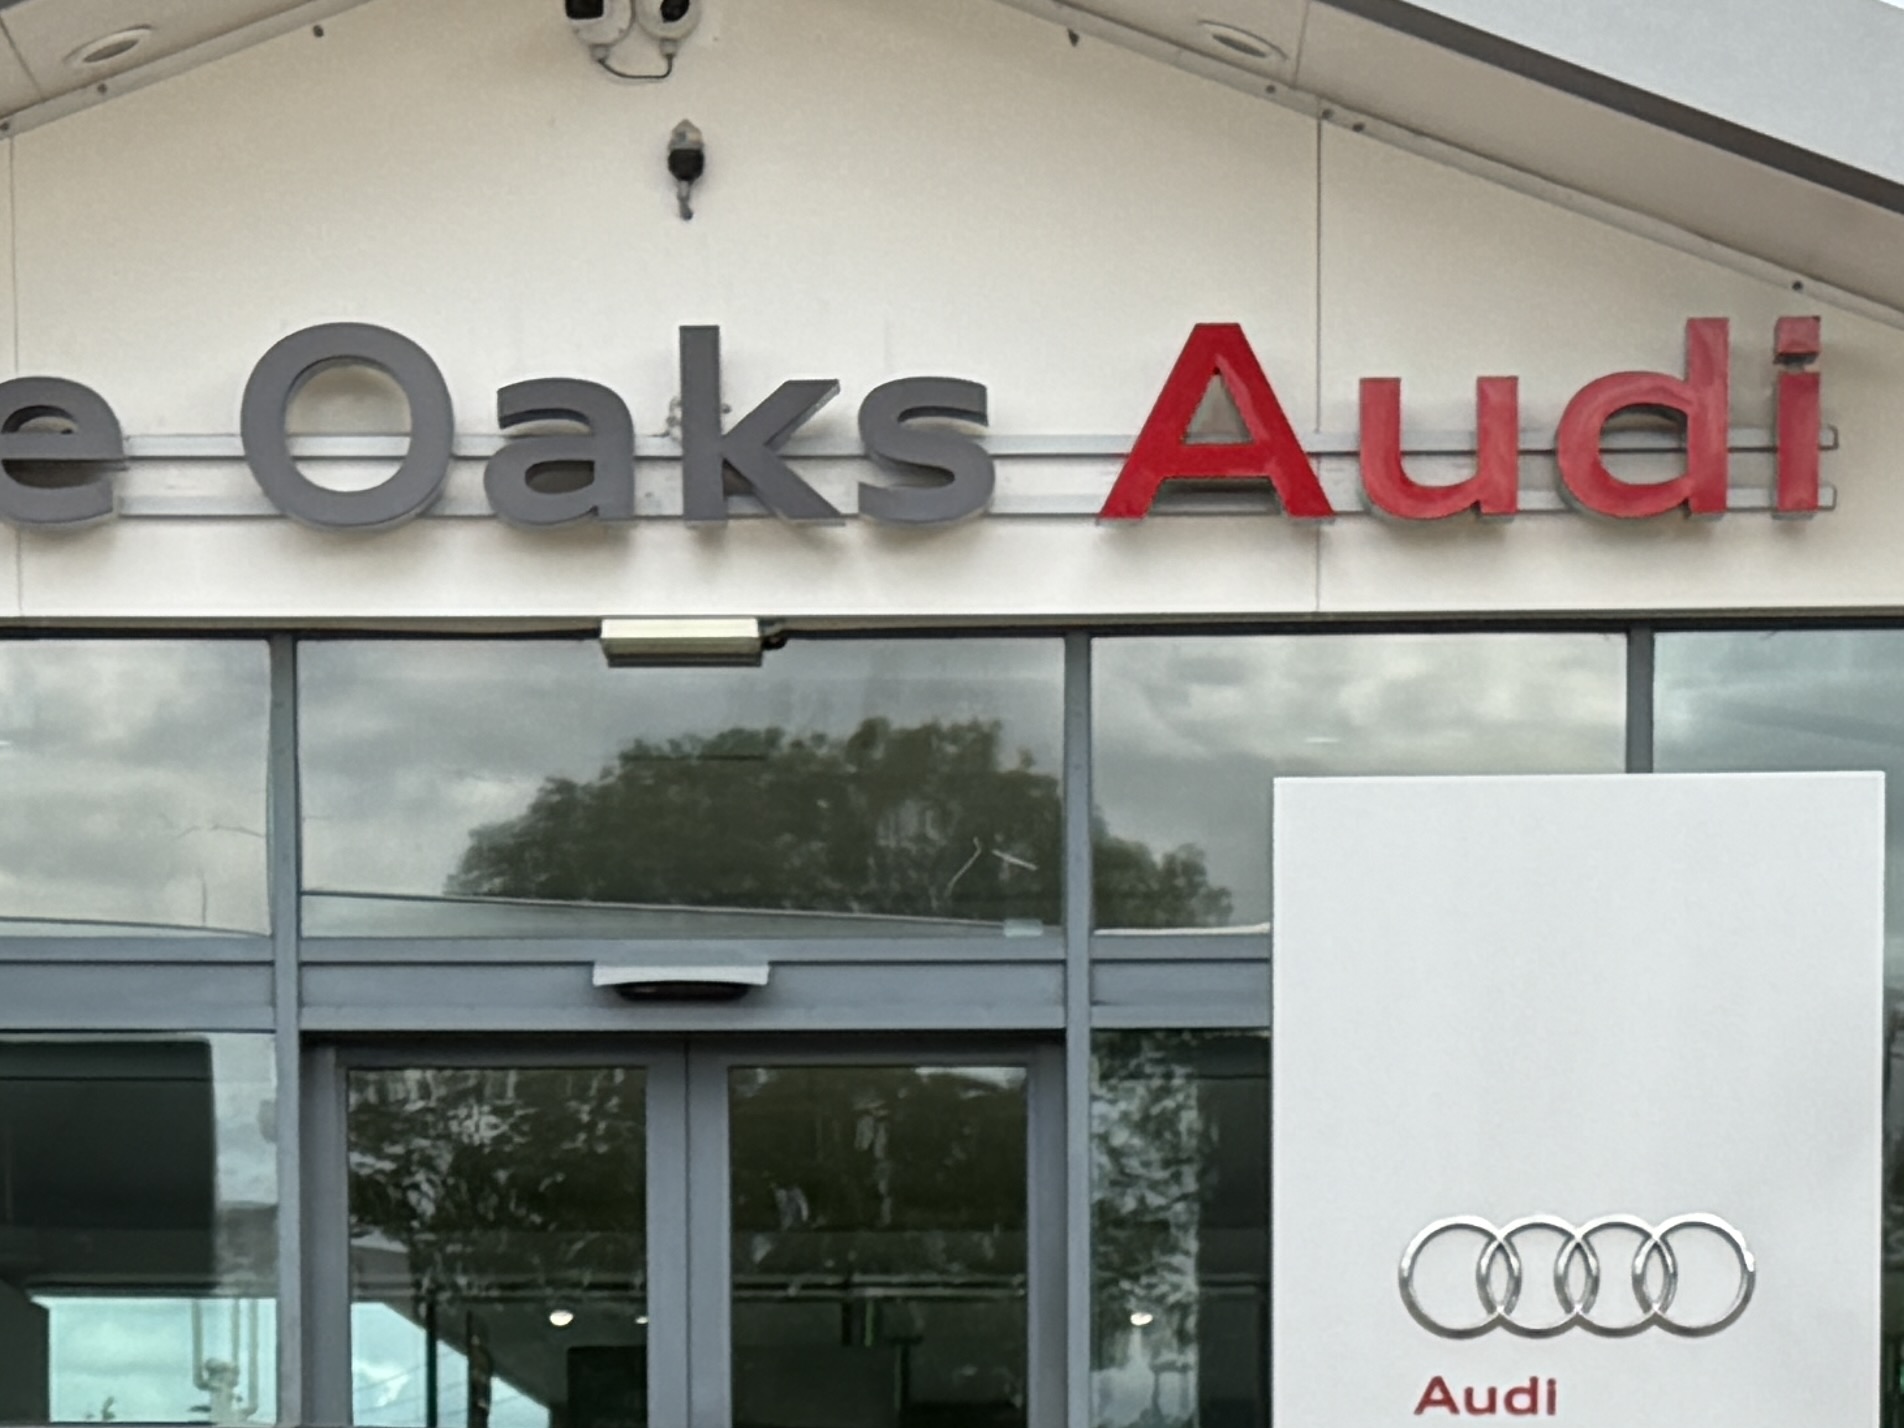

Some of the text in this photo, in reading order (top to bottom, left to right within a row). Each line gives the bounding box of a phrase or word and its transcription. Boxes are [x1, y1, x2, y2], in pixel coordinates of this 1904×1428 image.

[240, 322, 994, 528] Oaks
[1098, 317, 1828, 522] Audi
[1413, 1375, 1558, 1416] Audi
